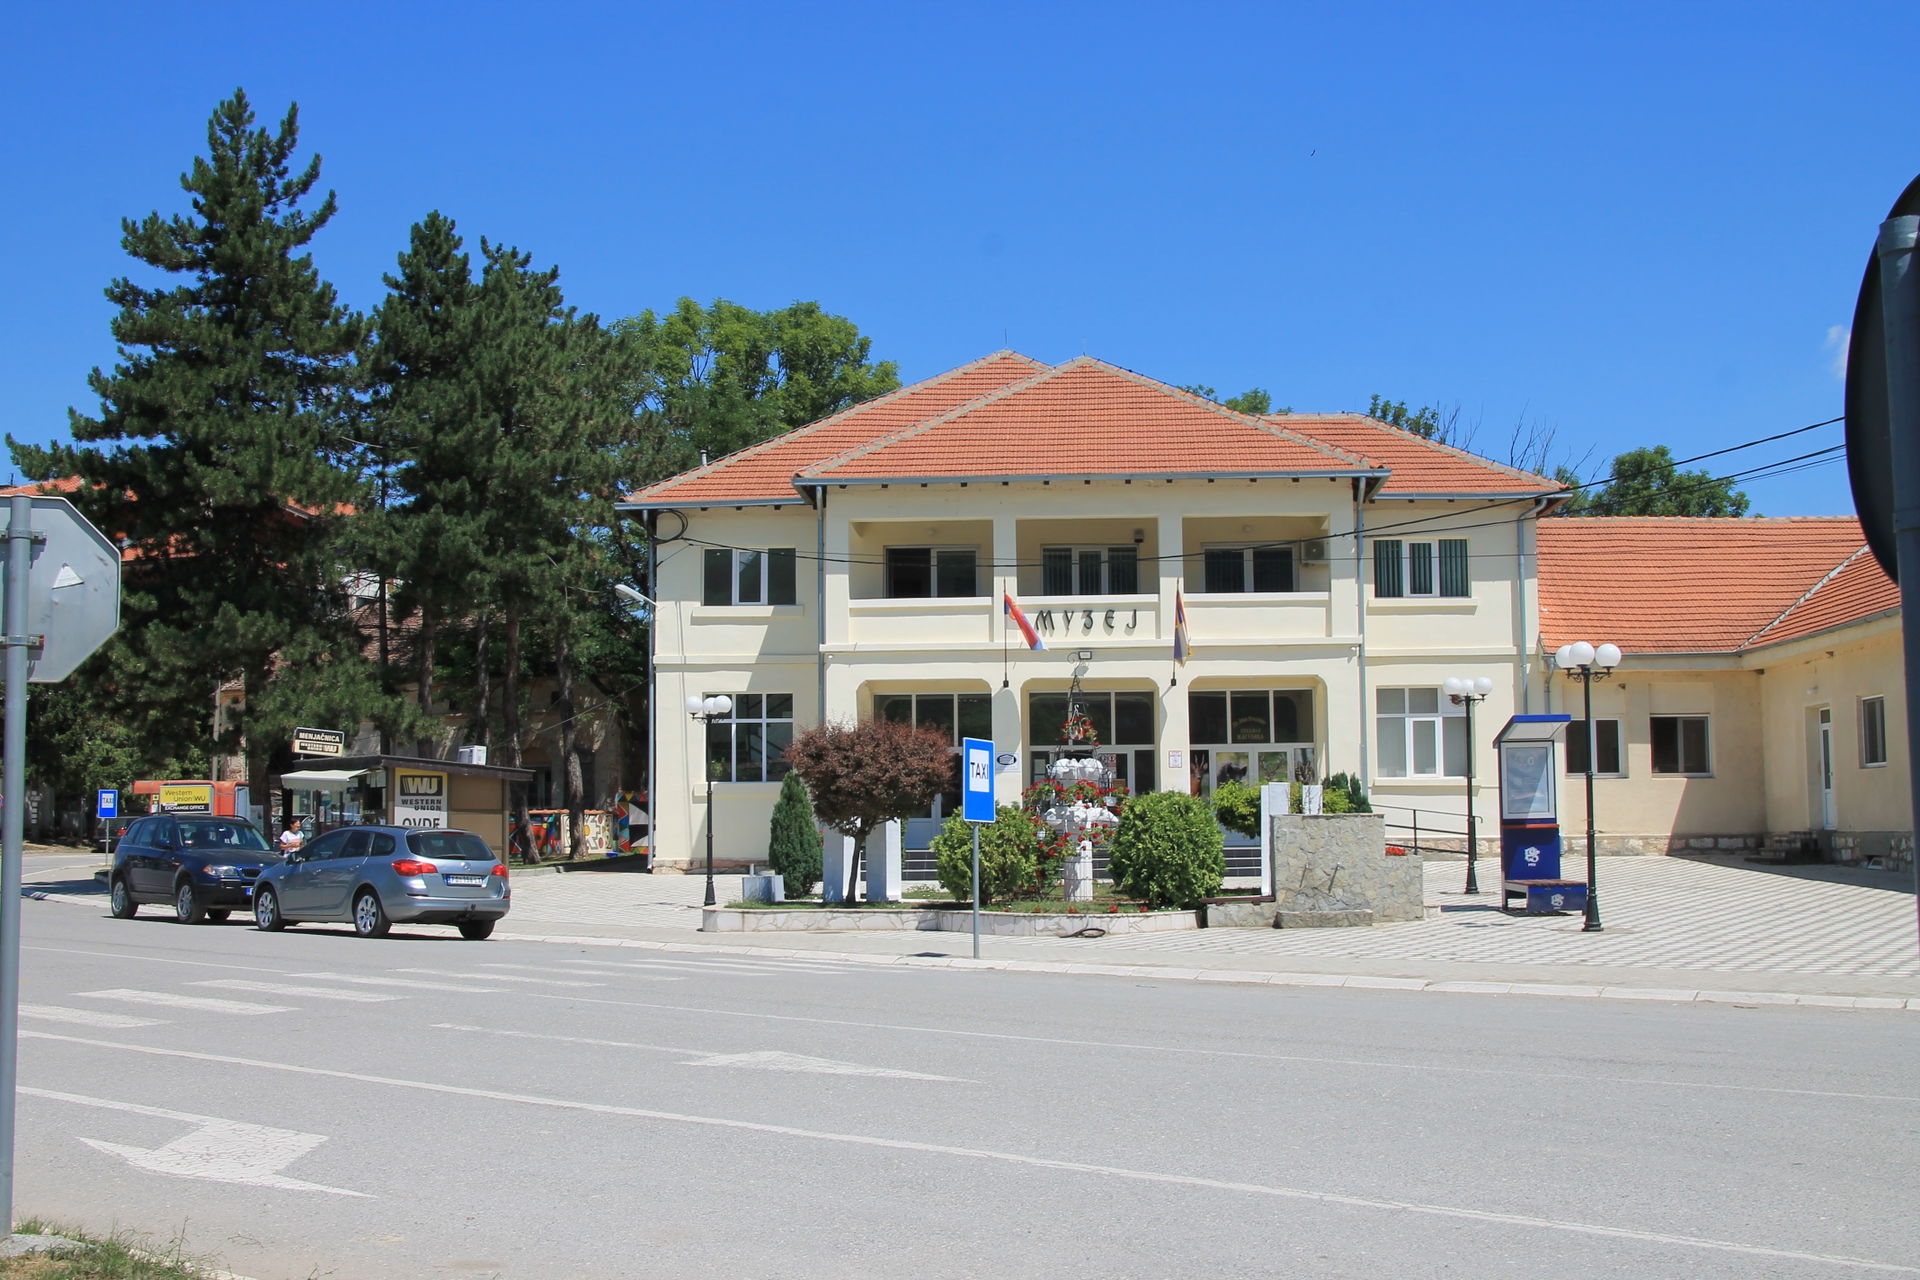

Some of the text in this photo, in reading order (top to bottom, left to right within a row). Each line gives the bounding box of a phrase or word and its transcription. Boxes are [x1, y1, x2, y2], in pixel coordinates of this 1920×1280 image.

[1035, 609, 1137, 630] МУЗЕЈ
[299, 732, 340, 742] MENJAČNICA
[970, 761, 989, 780] TAXI
[402, 776, 438, 795] WU
